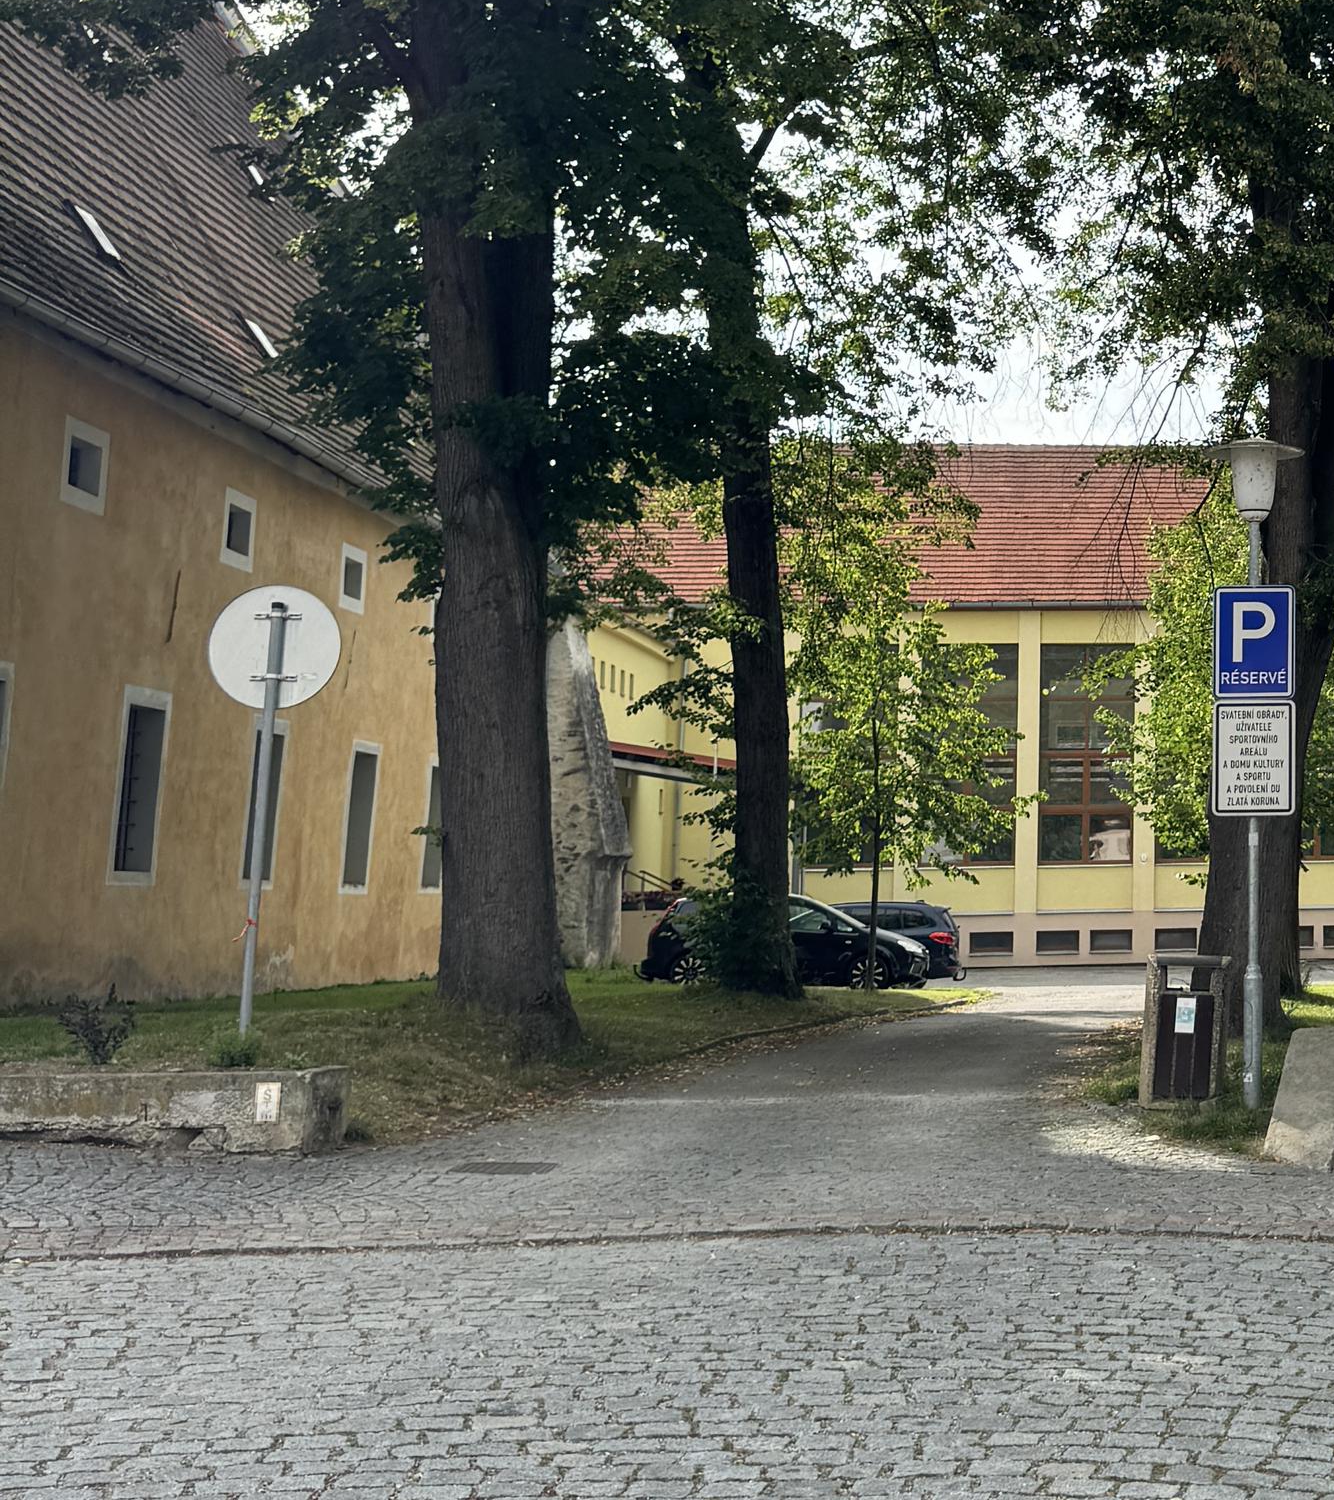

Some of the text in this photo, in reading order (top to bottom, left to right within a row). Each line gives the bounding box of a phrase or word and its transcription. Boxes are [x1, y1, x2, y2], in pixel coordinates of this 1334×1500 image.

[1232, 601, 1275, 663] P
[1221, 668, 1287, 685] RÉSERVÉ
[1221, 709, 1255, 720] SVATEBNÍ
[1235, 721, 1272, 732] UŽIVATELE
[1229, 733, 1278, 744] SPORTOVNÍHO
[1239, 745, 1268, 756] AREÁLU
[1223, 759, 1285, 769] A DOMU KULTURY
[1236, 772, 1271, 781] A SPORTU
[1226, 785, 1232, 793] A
[1233, 783, 1268, 793] POVOLENÍ
[1227, 795, 1280, 806] ZLATÁ KORUNA
